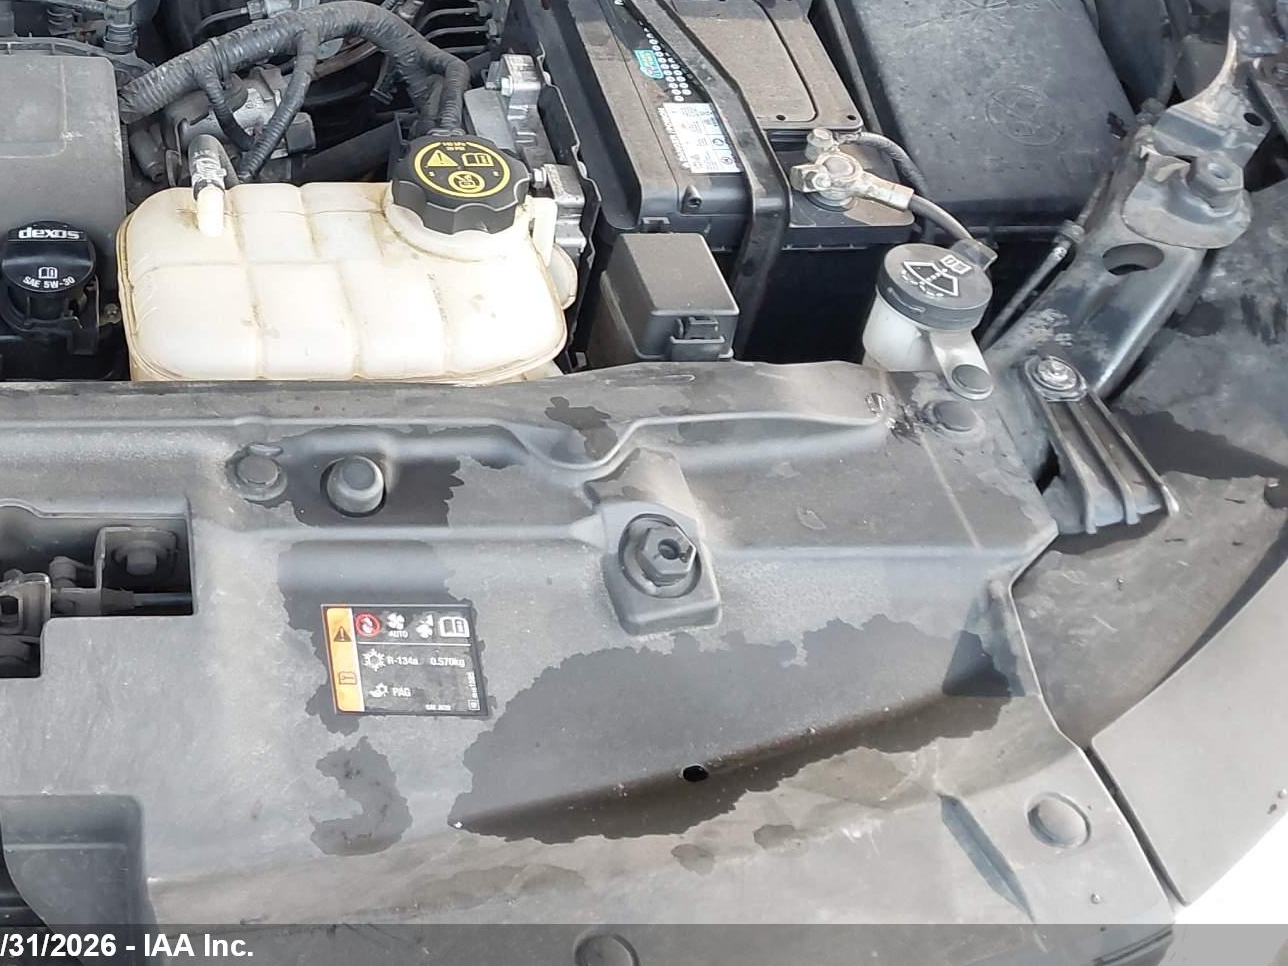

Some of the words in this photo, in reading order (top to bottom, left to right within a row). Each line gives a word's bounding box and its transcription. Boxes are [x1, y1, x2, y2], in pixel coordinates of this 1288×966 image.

[18, 226, 80, 239] dexos
[23, 276, 41, 288] SAE
[43, 276, 75, 288] 5W-30
[388, 630, 408, 638] AUTO
[387, 655, 419, 665] R-134a
[430, 657, 465, 667] 0.570kg
[392, 688, 411, 697] PAG
